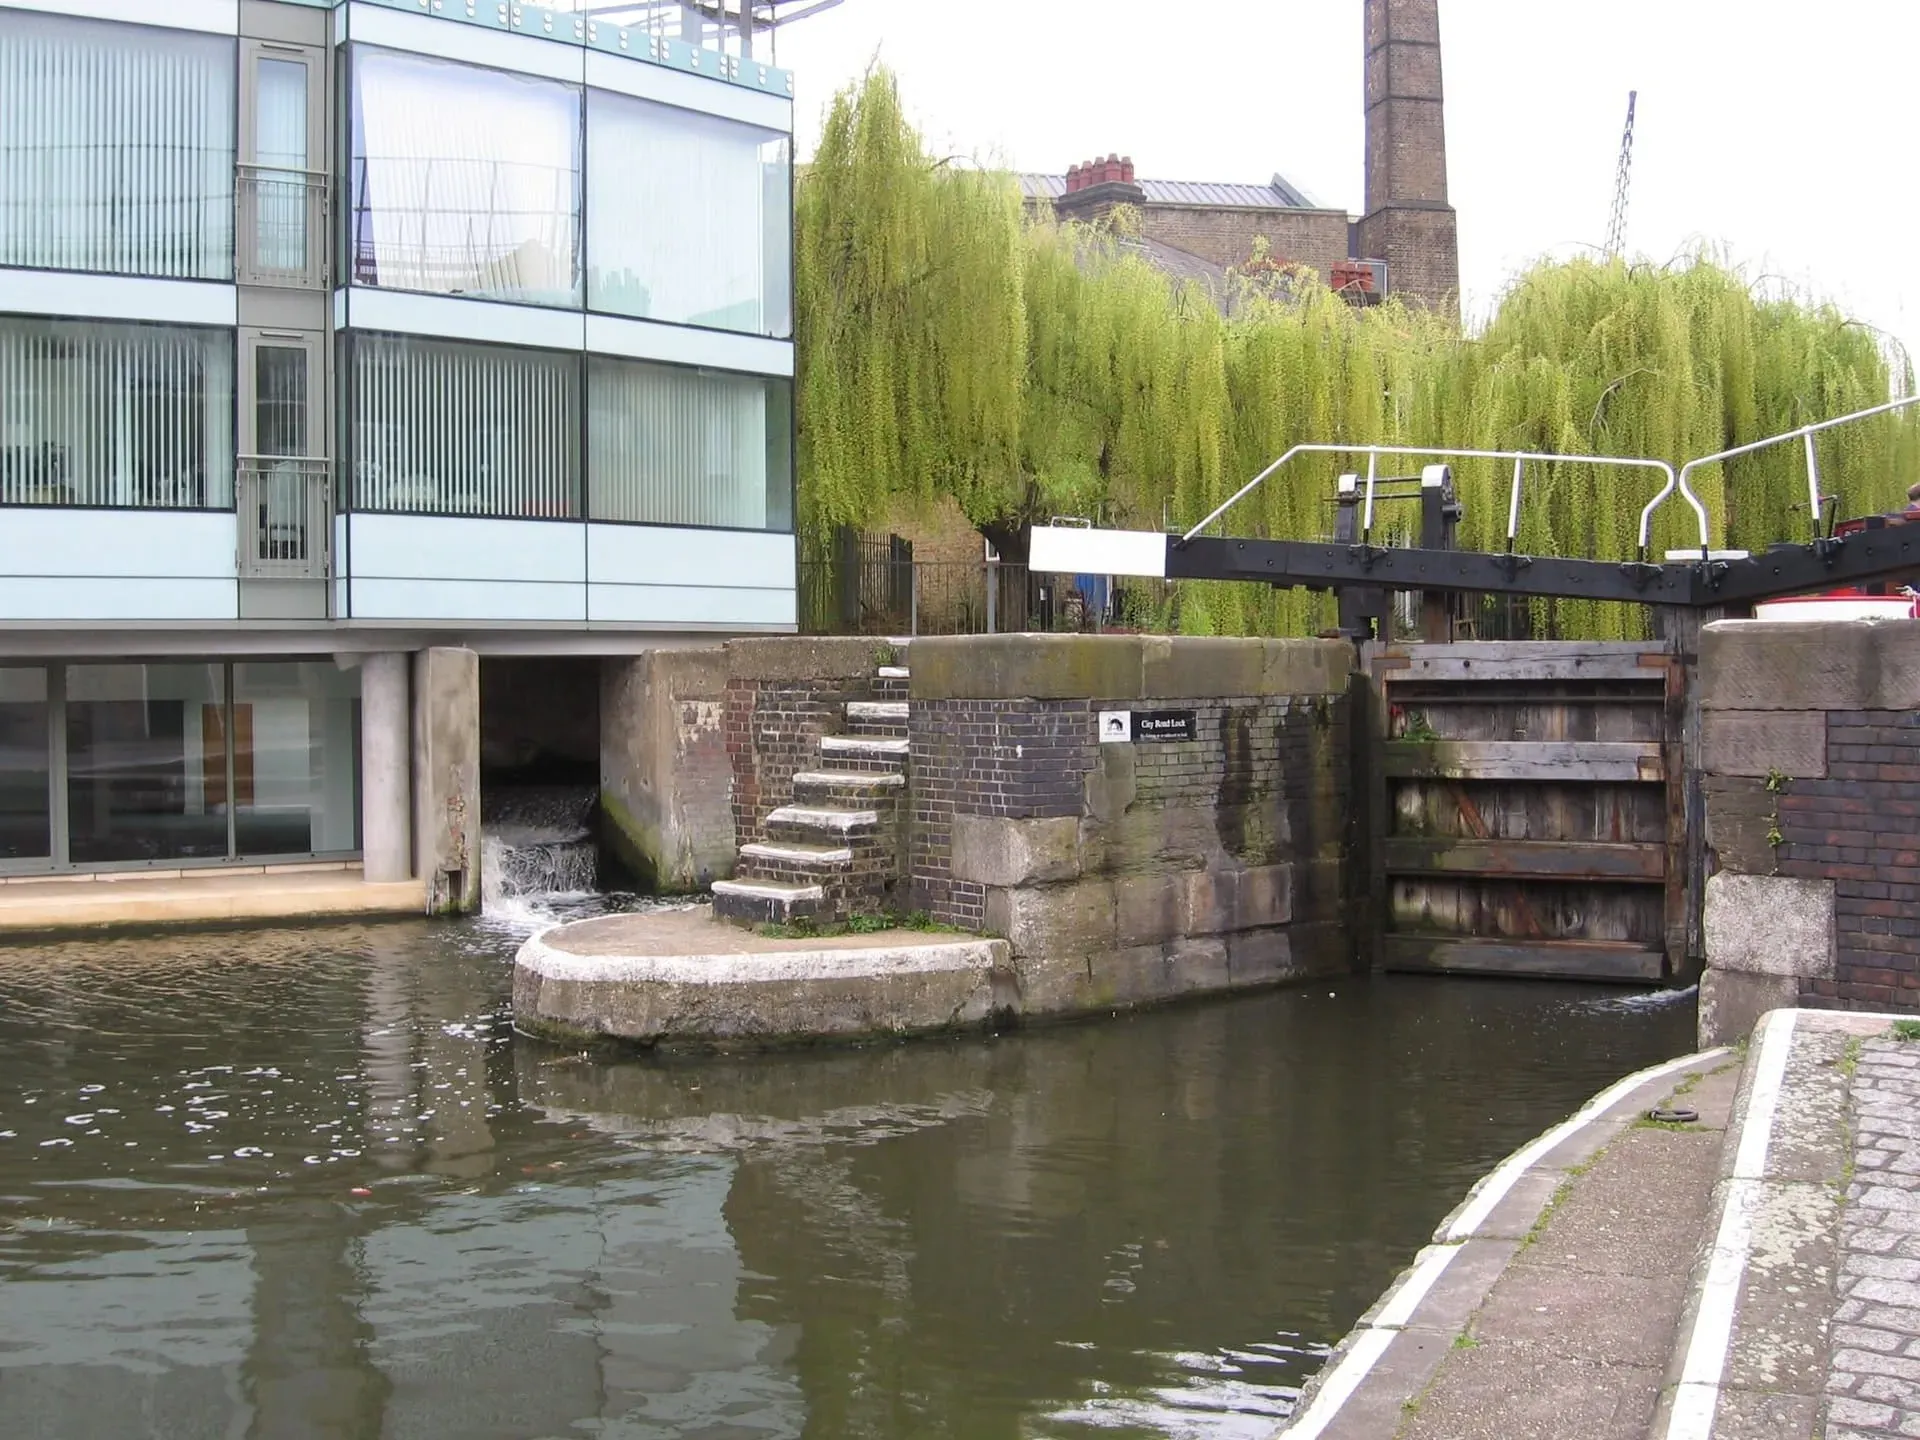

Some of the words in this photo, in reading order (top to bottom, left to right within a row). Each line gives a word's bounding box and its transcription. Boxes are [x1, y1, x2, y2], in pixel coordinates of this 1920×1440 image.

[1141, 719, 1154, 729] City
[1154, 719, 1170, 728] Road
[1171, 719, 1186, 727] Lock
